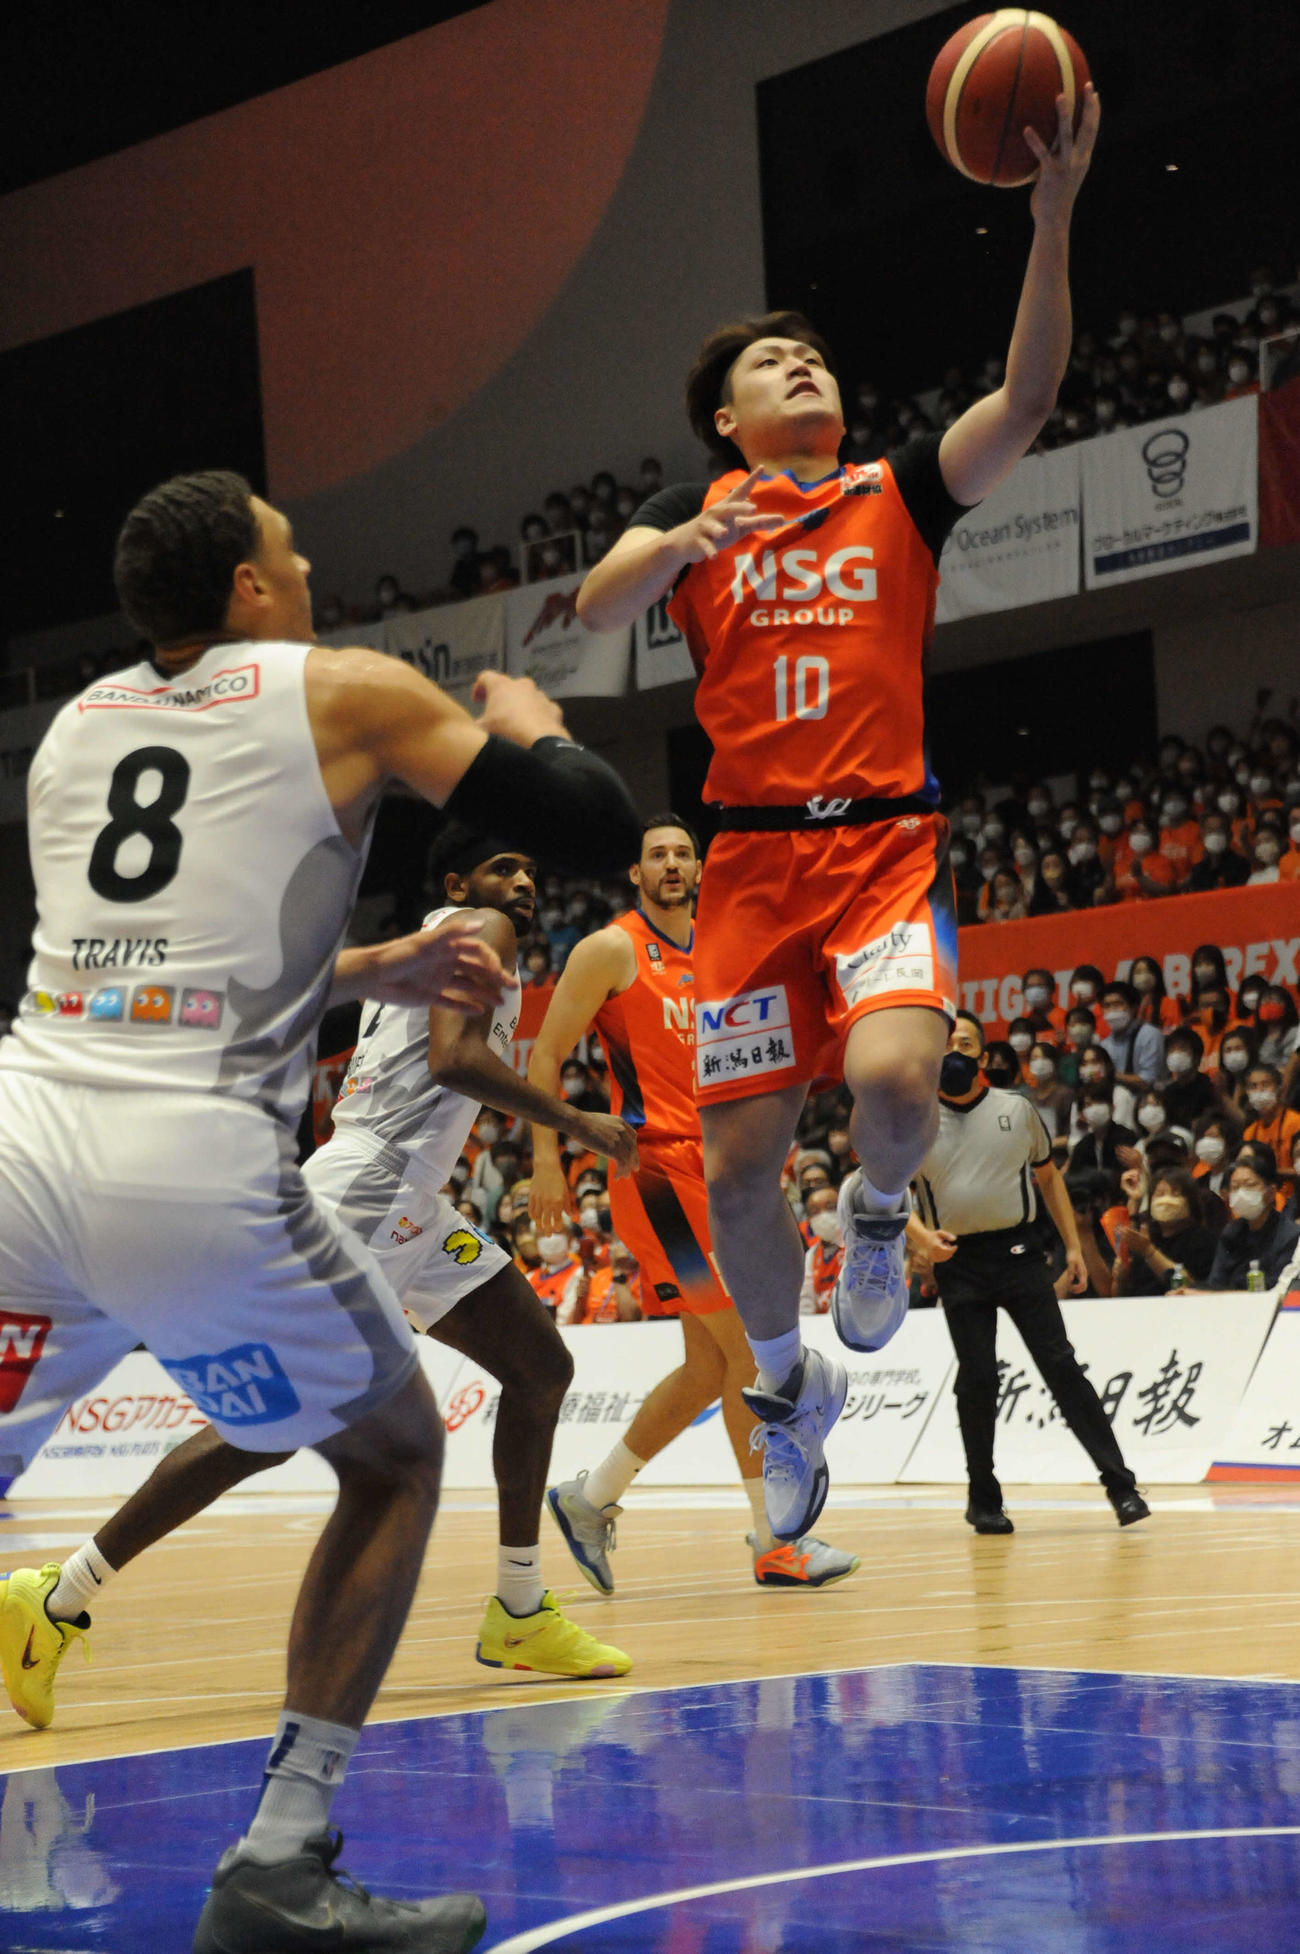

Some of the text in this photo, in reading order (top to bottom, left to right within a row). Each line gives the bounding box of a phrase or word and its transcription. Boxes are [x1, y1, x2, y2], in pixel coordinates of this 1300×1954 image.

[731, 547, 877, 604] NSG
[750, 608, 854, 627] GROUP
[774, 655, 830, 721] 10
[88, 746, 190, 903] 8
[72, 938, 168, 971] TRAVIS
[702, 995, 777, 1034] NCT
[703, 1037, 790, 1077] 新潟日報
